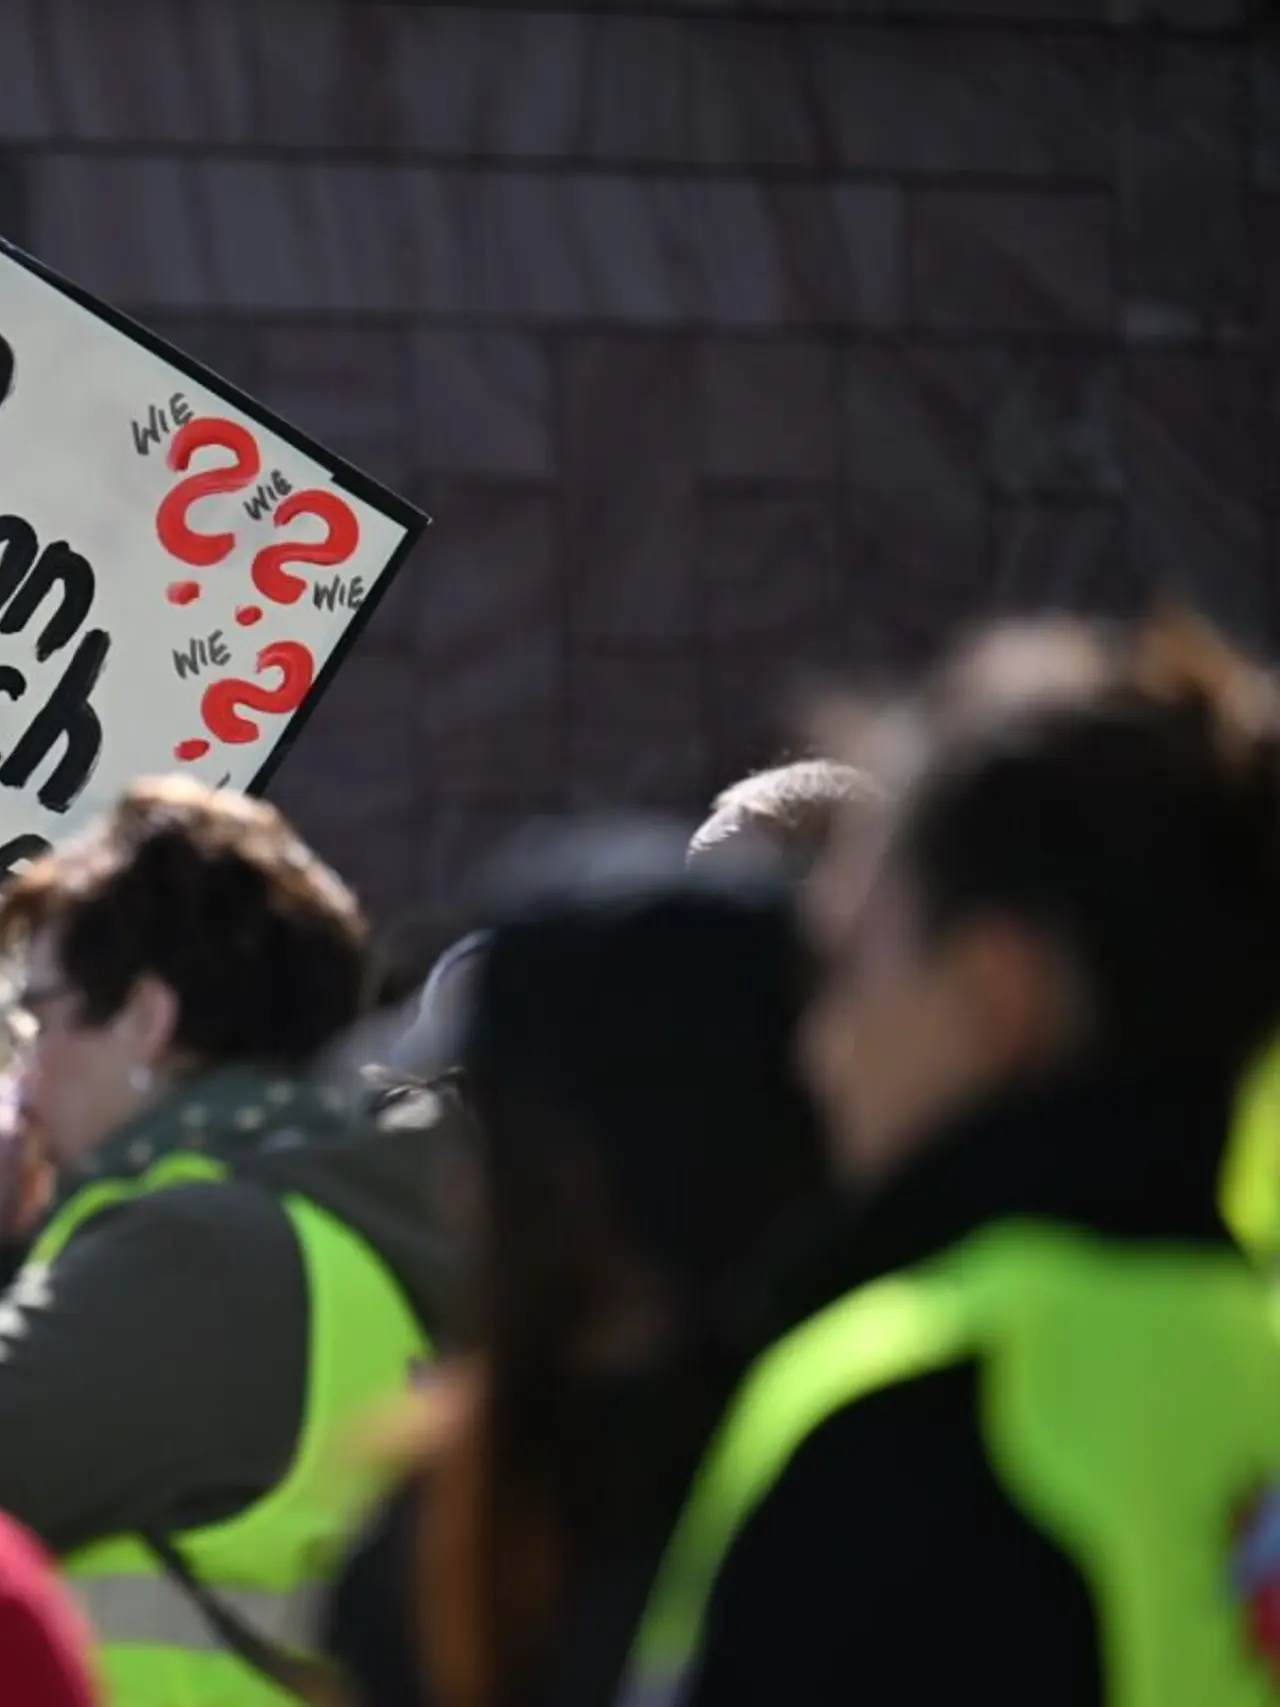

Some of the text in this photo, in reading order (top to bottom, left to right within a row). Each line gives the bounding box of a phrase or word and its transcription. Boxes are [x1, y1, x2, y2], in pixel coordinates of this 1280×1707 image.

[130, 393, 194, 456] WIE
[243, 469, 293, 522] WIE
[313, 575, 366, 612] WIE
[173, 630, 231, 679] WIE
